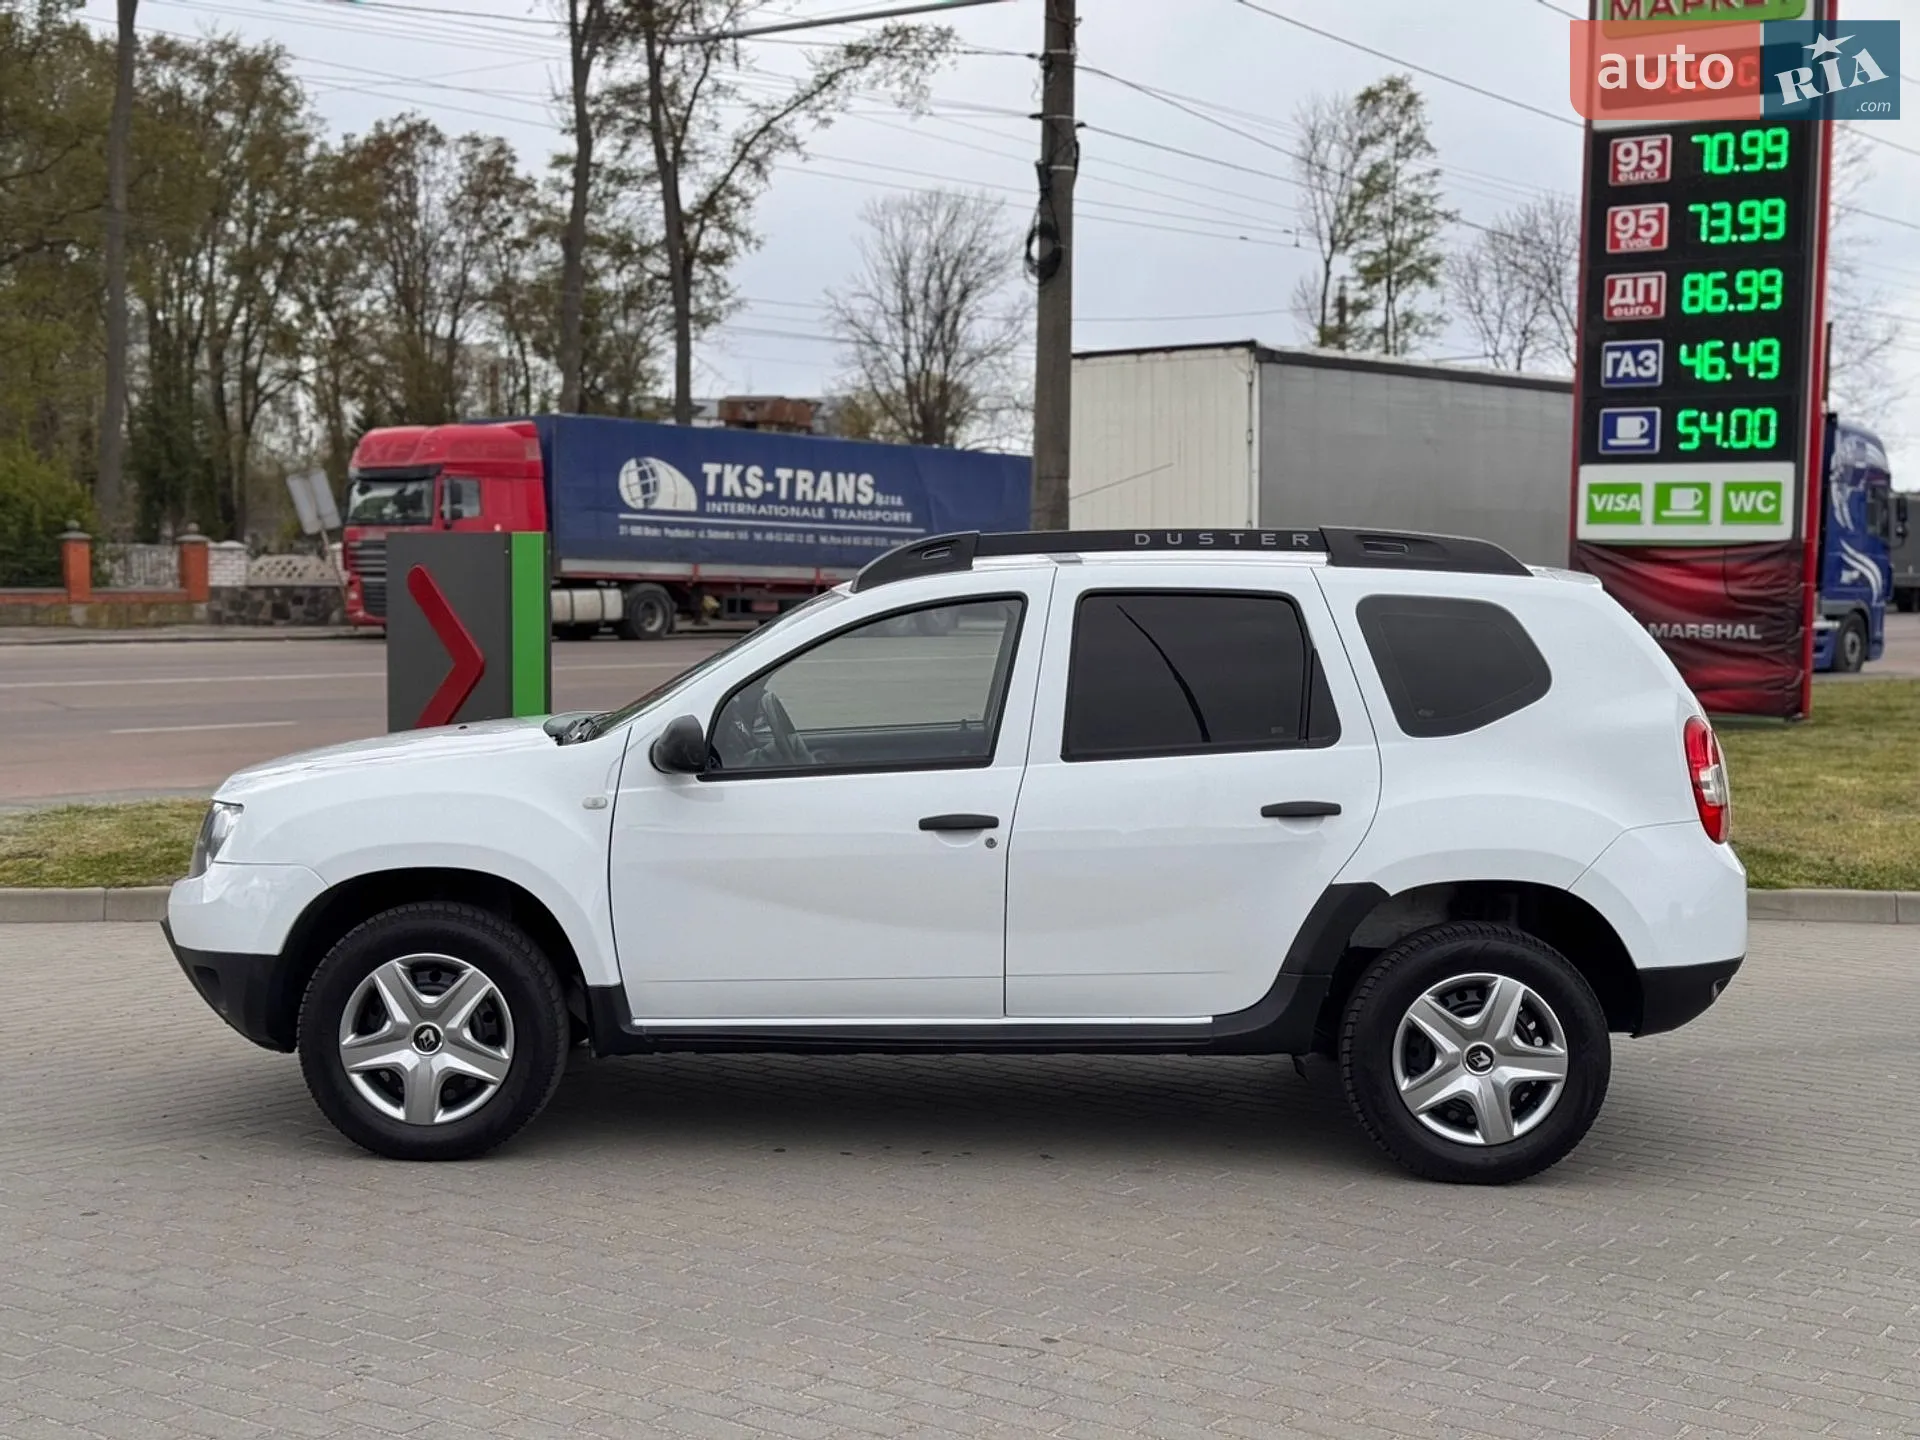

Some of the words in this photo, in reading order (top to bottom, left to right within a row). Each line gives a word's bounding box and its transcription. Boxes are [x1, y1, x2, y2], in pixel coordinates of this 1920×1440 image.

[1616, 140, 1663, 172] 95
[1690, 127, 1789, 175] 70.99
[1617, 170, 1659, 183] euro
[1614, 209, 1660, 240] 95
[1687, 198, 1787, 244] 73.99
[1609, 276, 1659, 306] ДП
[1681, 268, 1784, 314] 86.99
[1612, 304, 1653, 317] euro
[1605, 350, 1657, 379] ГАЗ
[1679, 338, 1780, 382] 46.49
[1676, 408, 1777, 450] 54.00
[702, 463, 875, 505] TKS-TRANS
[705, 502, 826, 519] INTERNATIONALE
[831, 508, 913, 524] TRANSPORTE
[1591, 493, 1640, 512] VISA
[1728, 490, 1776, 513] WC
[1134, 533, 1310, 546] DUSTER
[1648, 623, 1763, 640] MARSHAL
